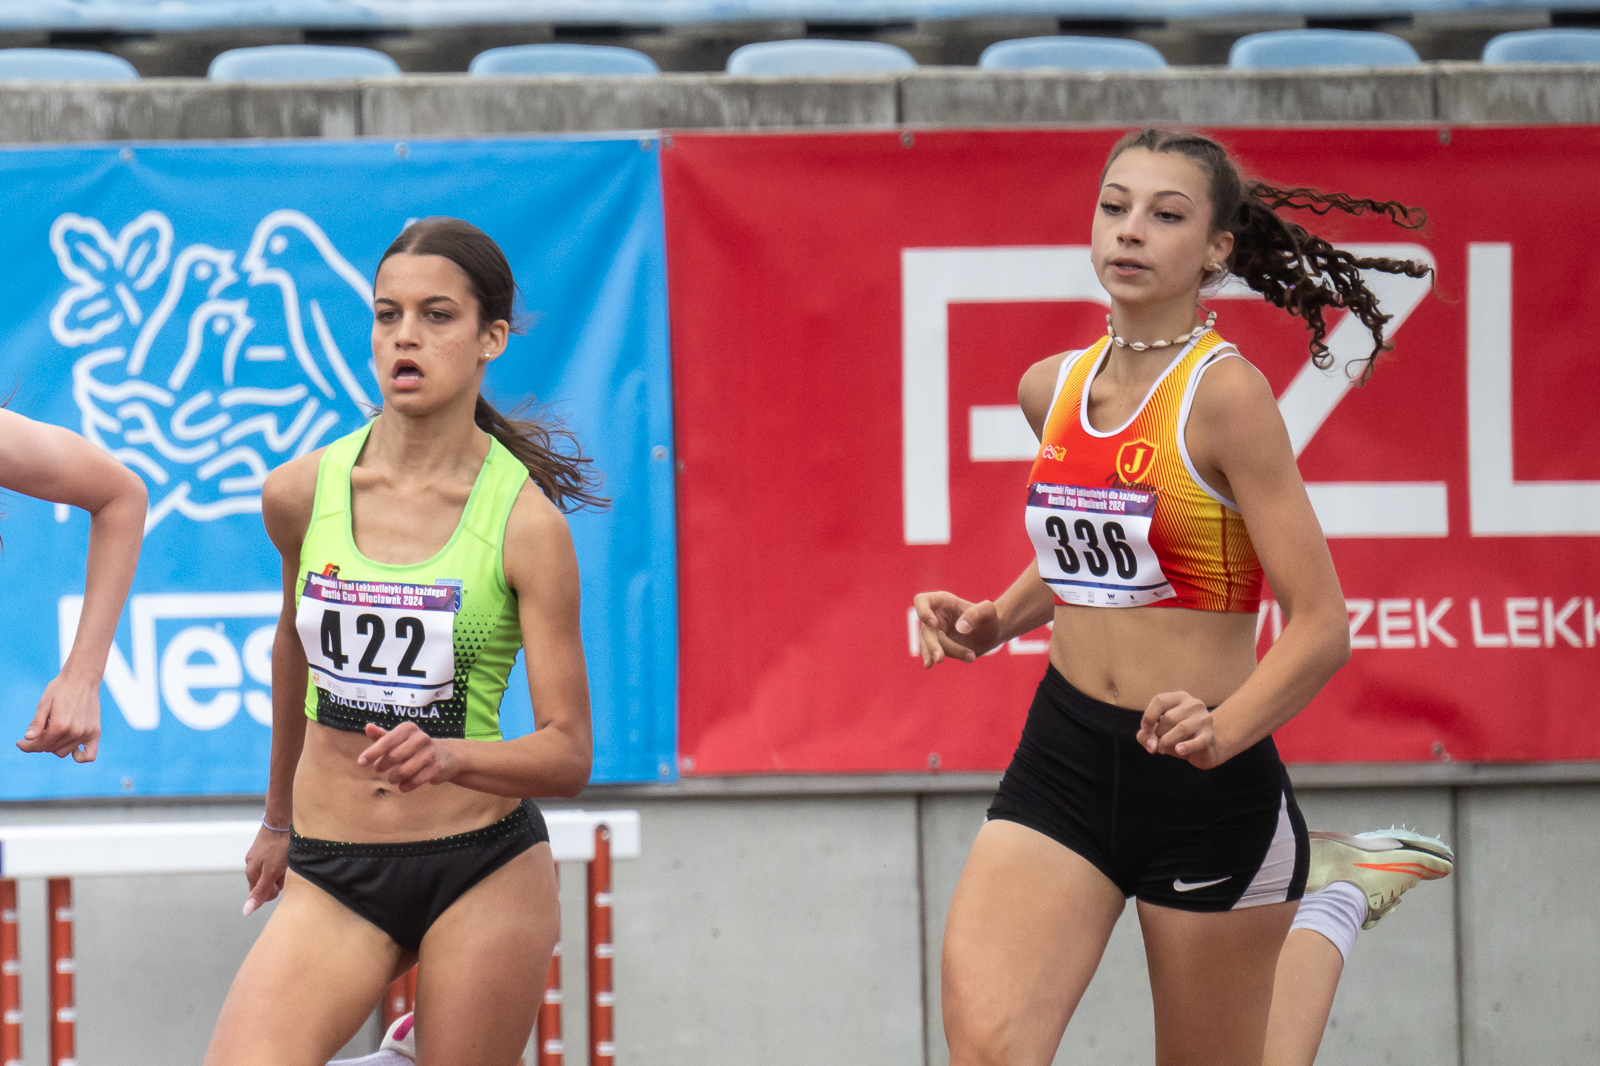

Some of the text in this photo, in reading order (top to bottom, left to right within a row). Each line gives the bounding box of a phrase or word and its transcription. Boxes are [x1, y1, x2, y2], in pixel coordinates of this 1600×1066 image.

[1045, 515, 1138, 580] 336
[402, 586, 413, 595] dla
[342, 592, 357, 603] Cup
[403, 595, 424, 607] 2024
[320, 608, 427, 679] 422
[392, 705, 440, 719] WOLA
